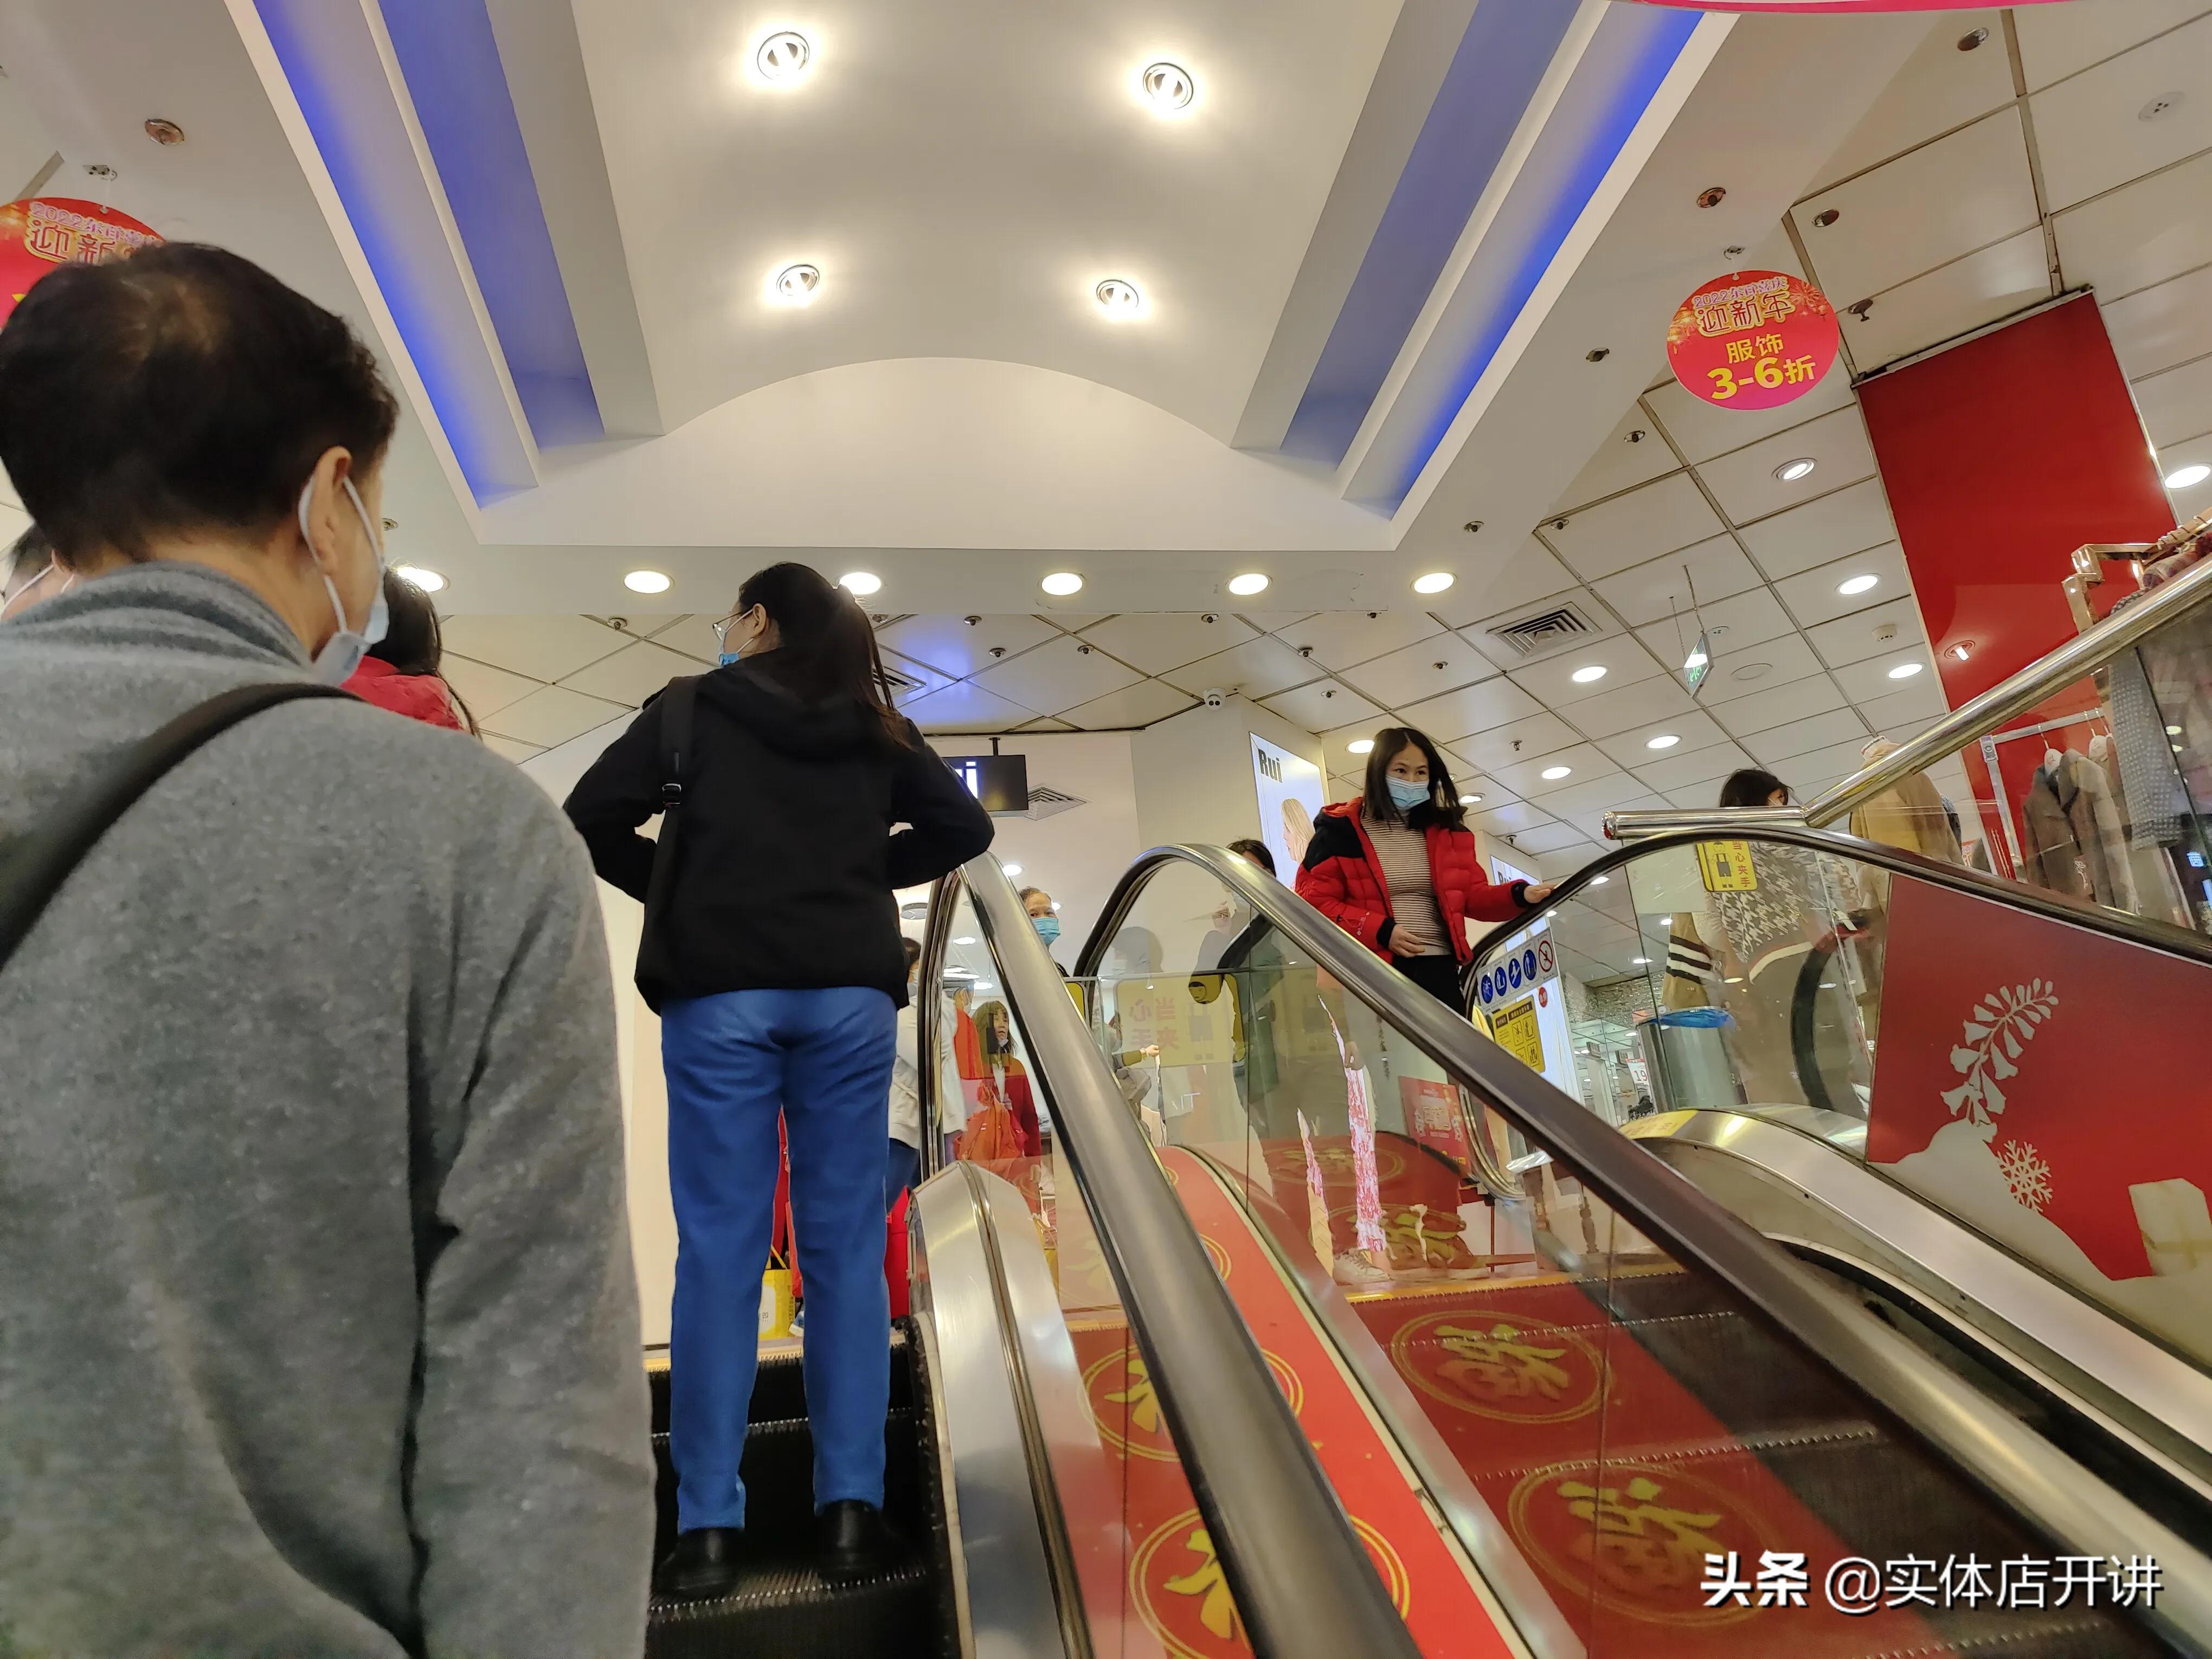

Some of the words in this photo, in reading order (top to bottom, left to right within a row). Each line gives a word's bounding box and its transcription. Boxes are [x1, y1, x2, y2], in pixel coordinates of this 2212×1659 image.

[30, 219, 133, 265] 迎新
[1697, 293, 1792, 333] 迎新年
[1725, 333, 1785, 364] 服饰
[1707, 354, 1817, 400] 3-6折
[1258, 748, 1283, 783] Rui
[1732, 841, 1751, 888] 当心夹手
